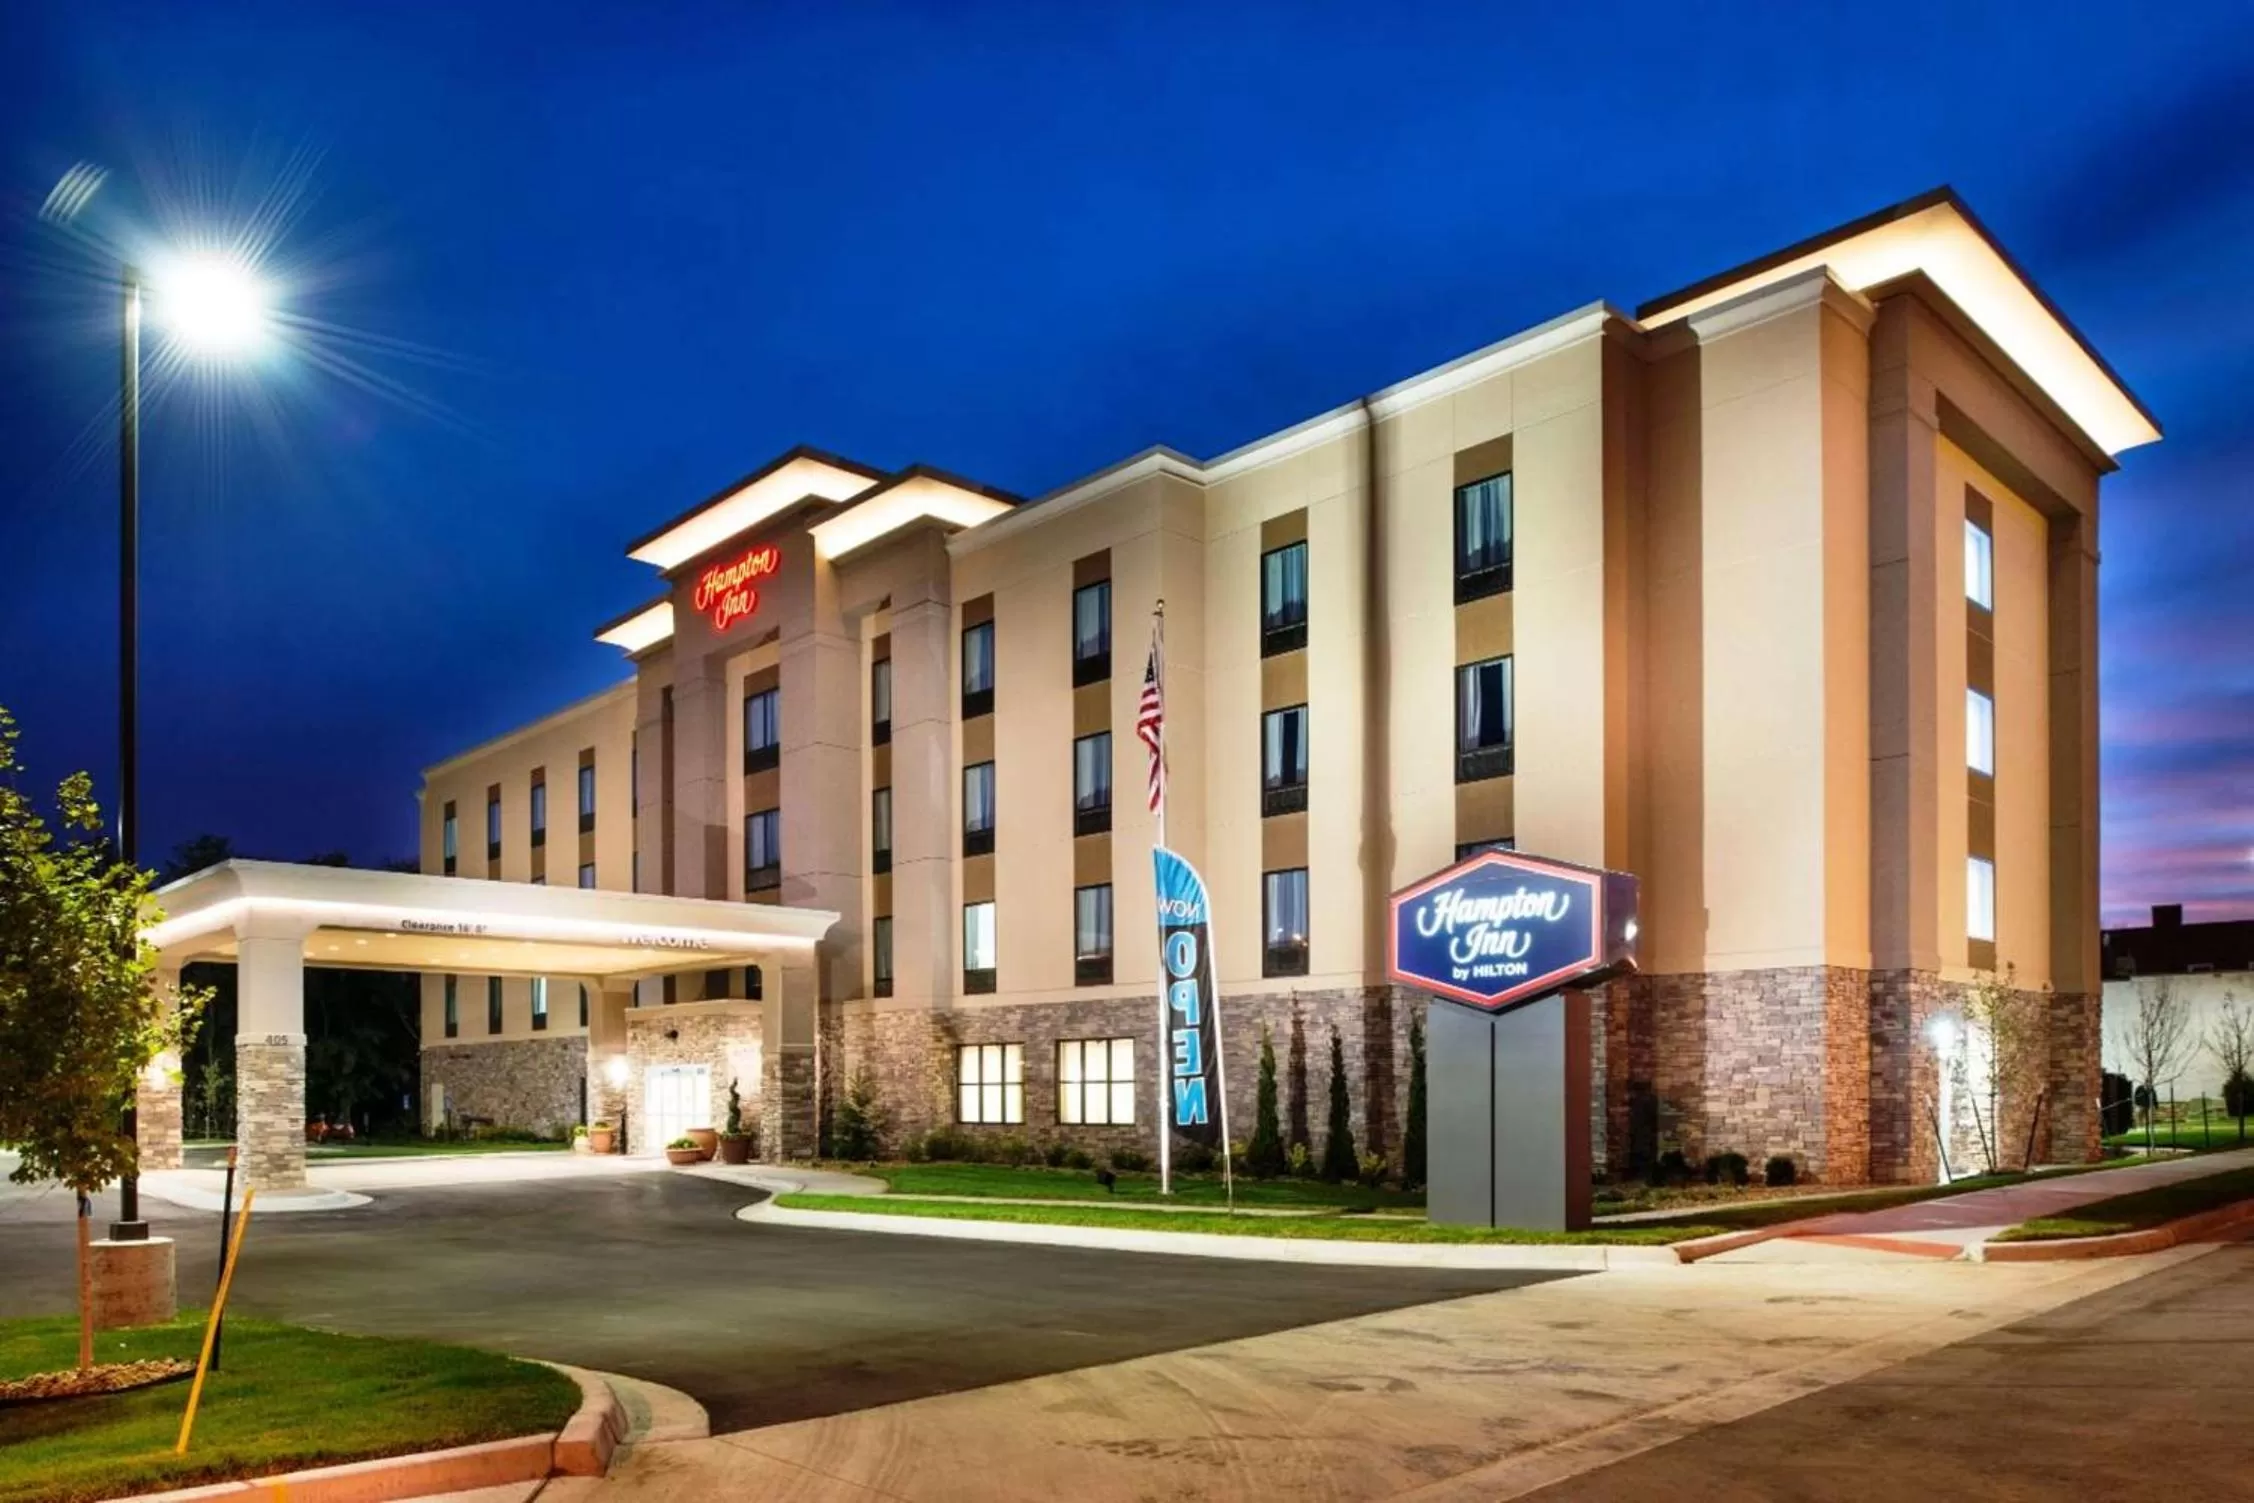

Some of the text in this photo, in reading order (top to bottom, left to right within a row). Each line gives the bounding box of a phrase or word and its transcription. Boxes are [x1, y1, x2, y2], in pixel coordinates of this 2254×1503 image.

[695, 547, 778, 610] Hampton
[715, 589, 755, 629] Inn
[1416, 885, 1570, 937] Hampton
[1450, 922, 1532, 964] Inn
[1452, 962, 1528, 980] by HILTON
[265, 1034, 289, 1046] 405
